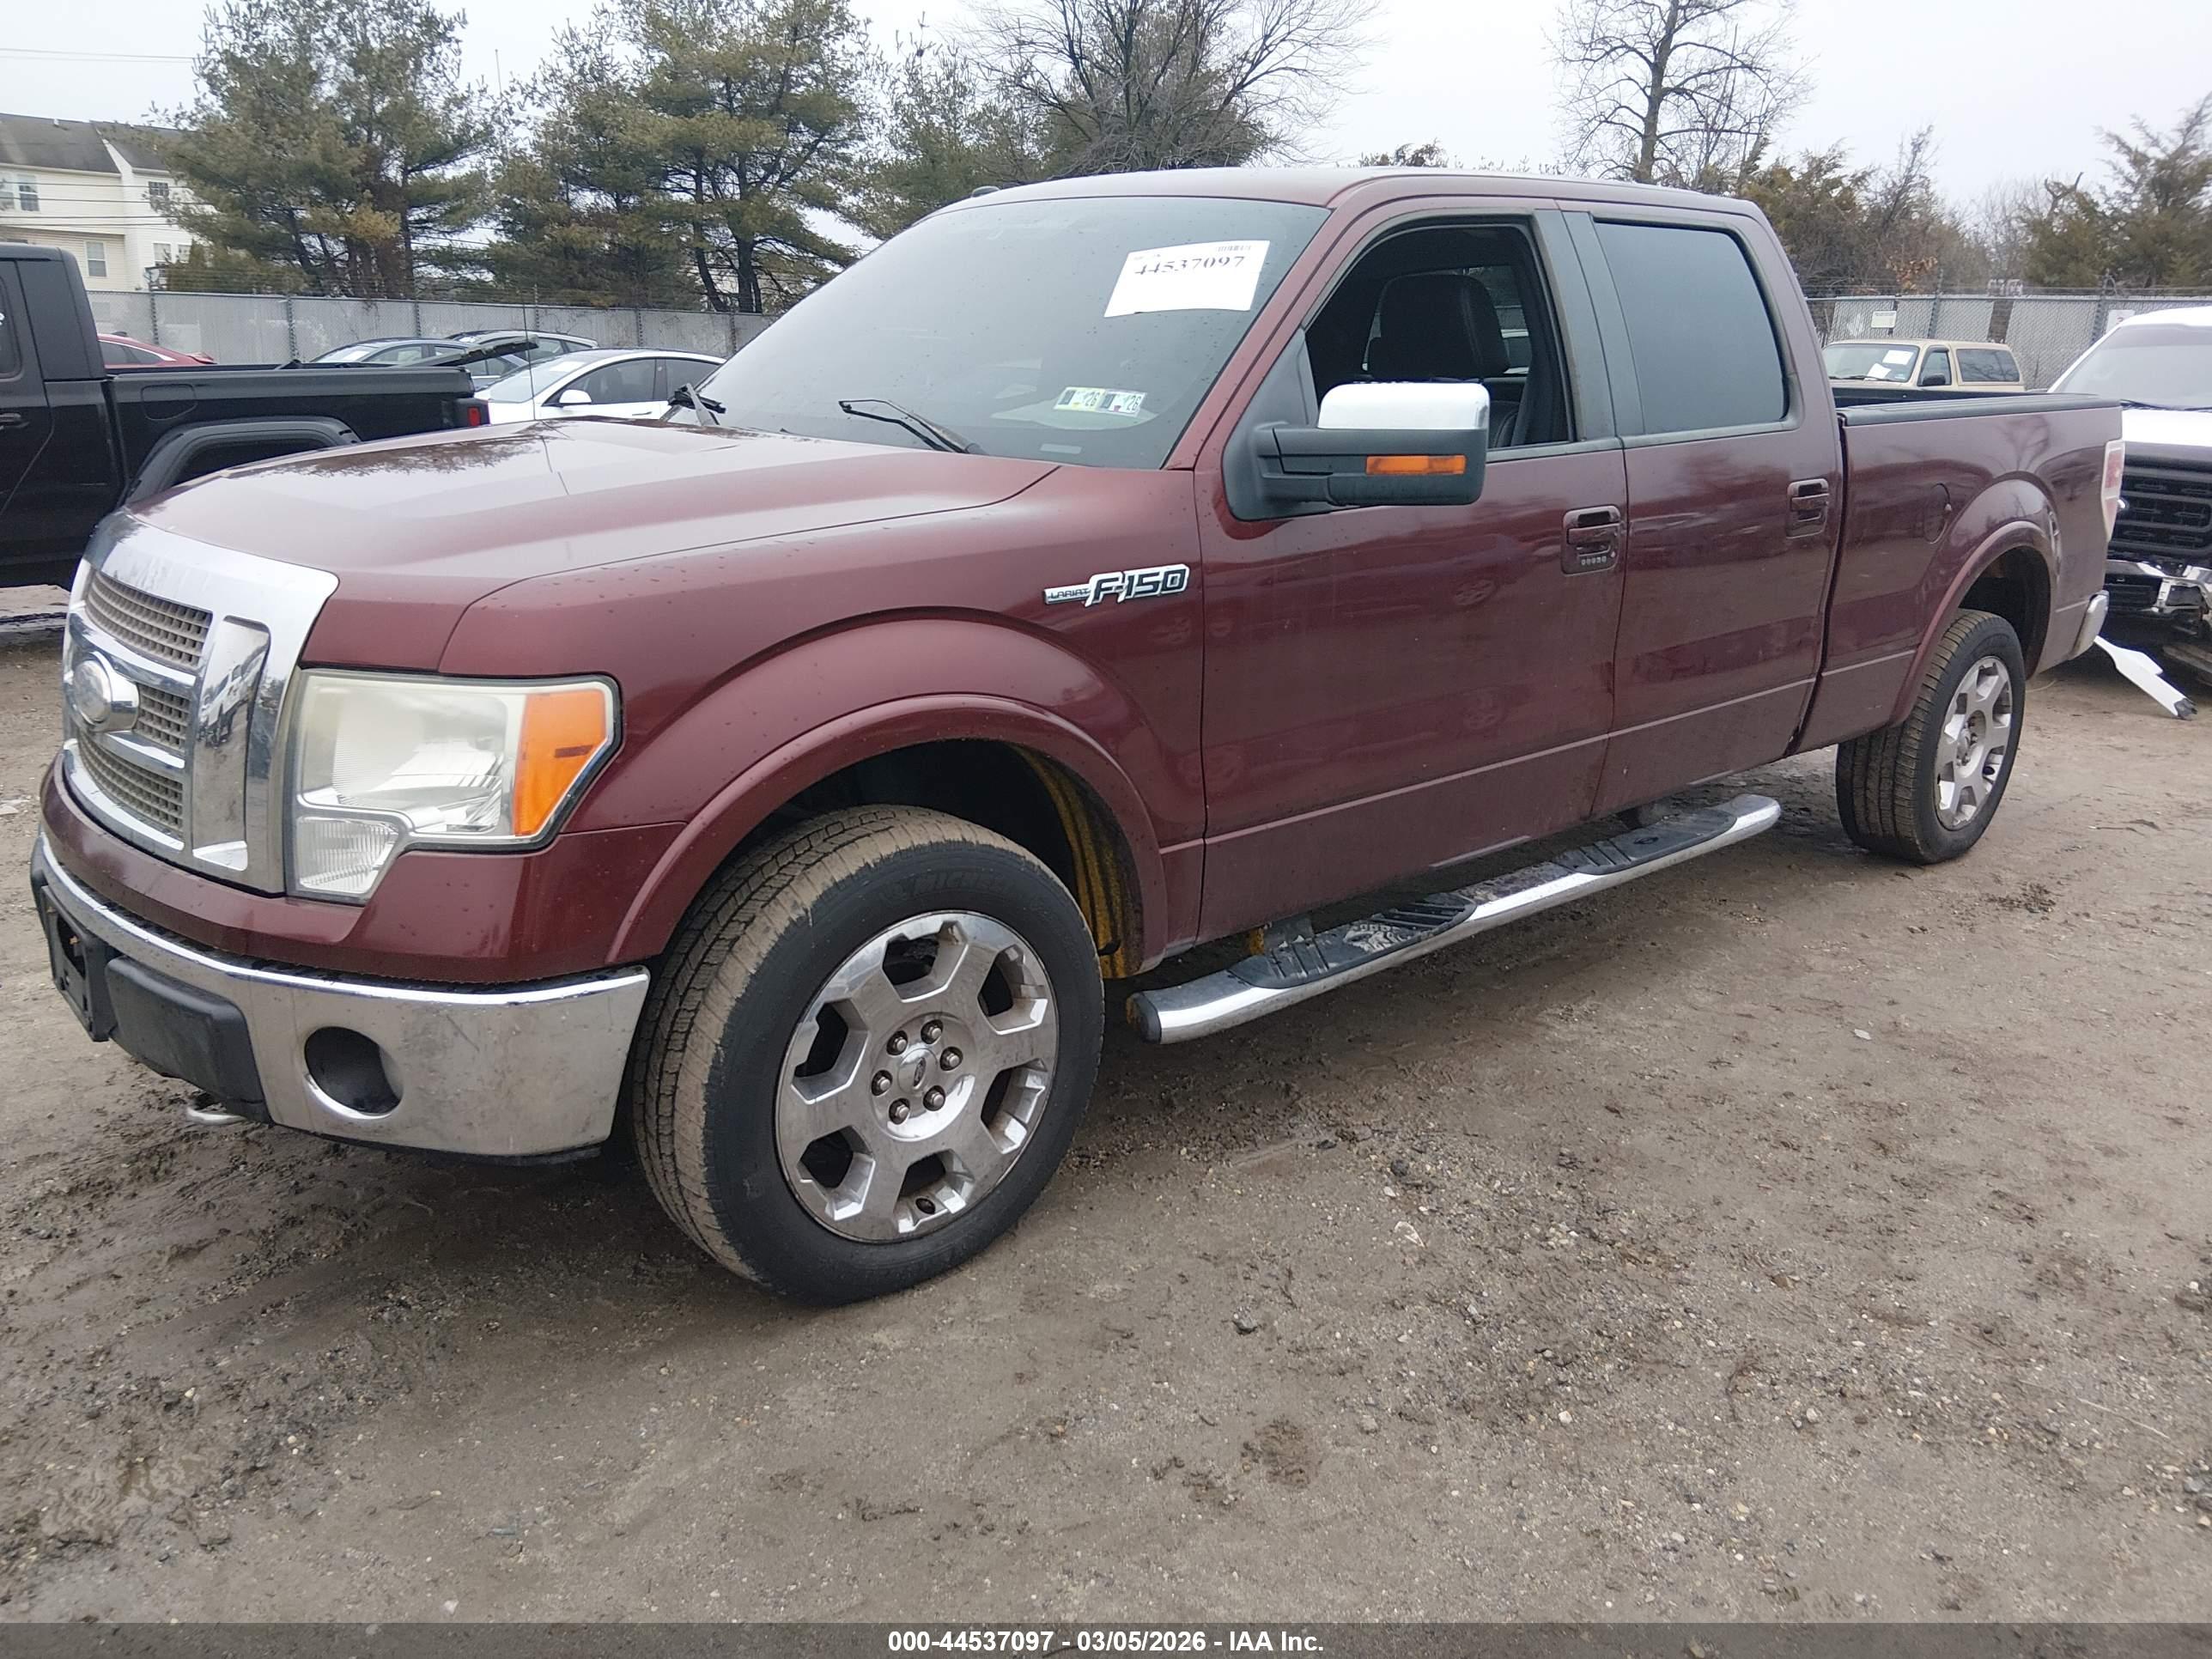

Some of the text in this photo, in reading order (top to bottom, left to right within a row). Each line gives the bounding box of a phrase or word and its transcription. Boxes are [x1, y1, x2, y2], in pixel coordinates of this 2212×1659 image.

[1133, 256, 1245, 276] 44537097
[1049, 564, 1190, 605] LARIAT F-150
